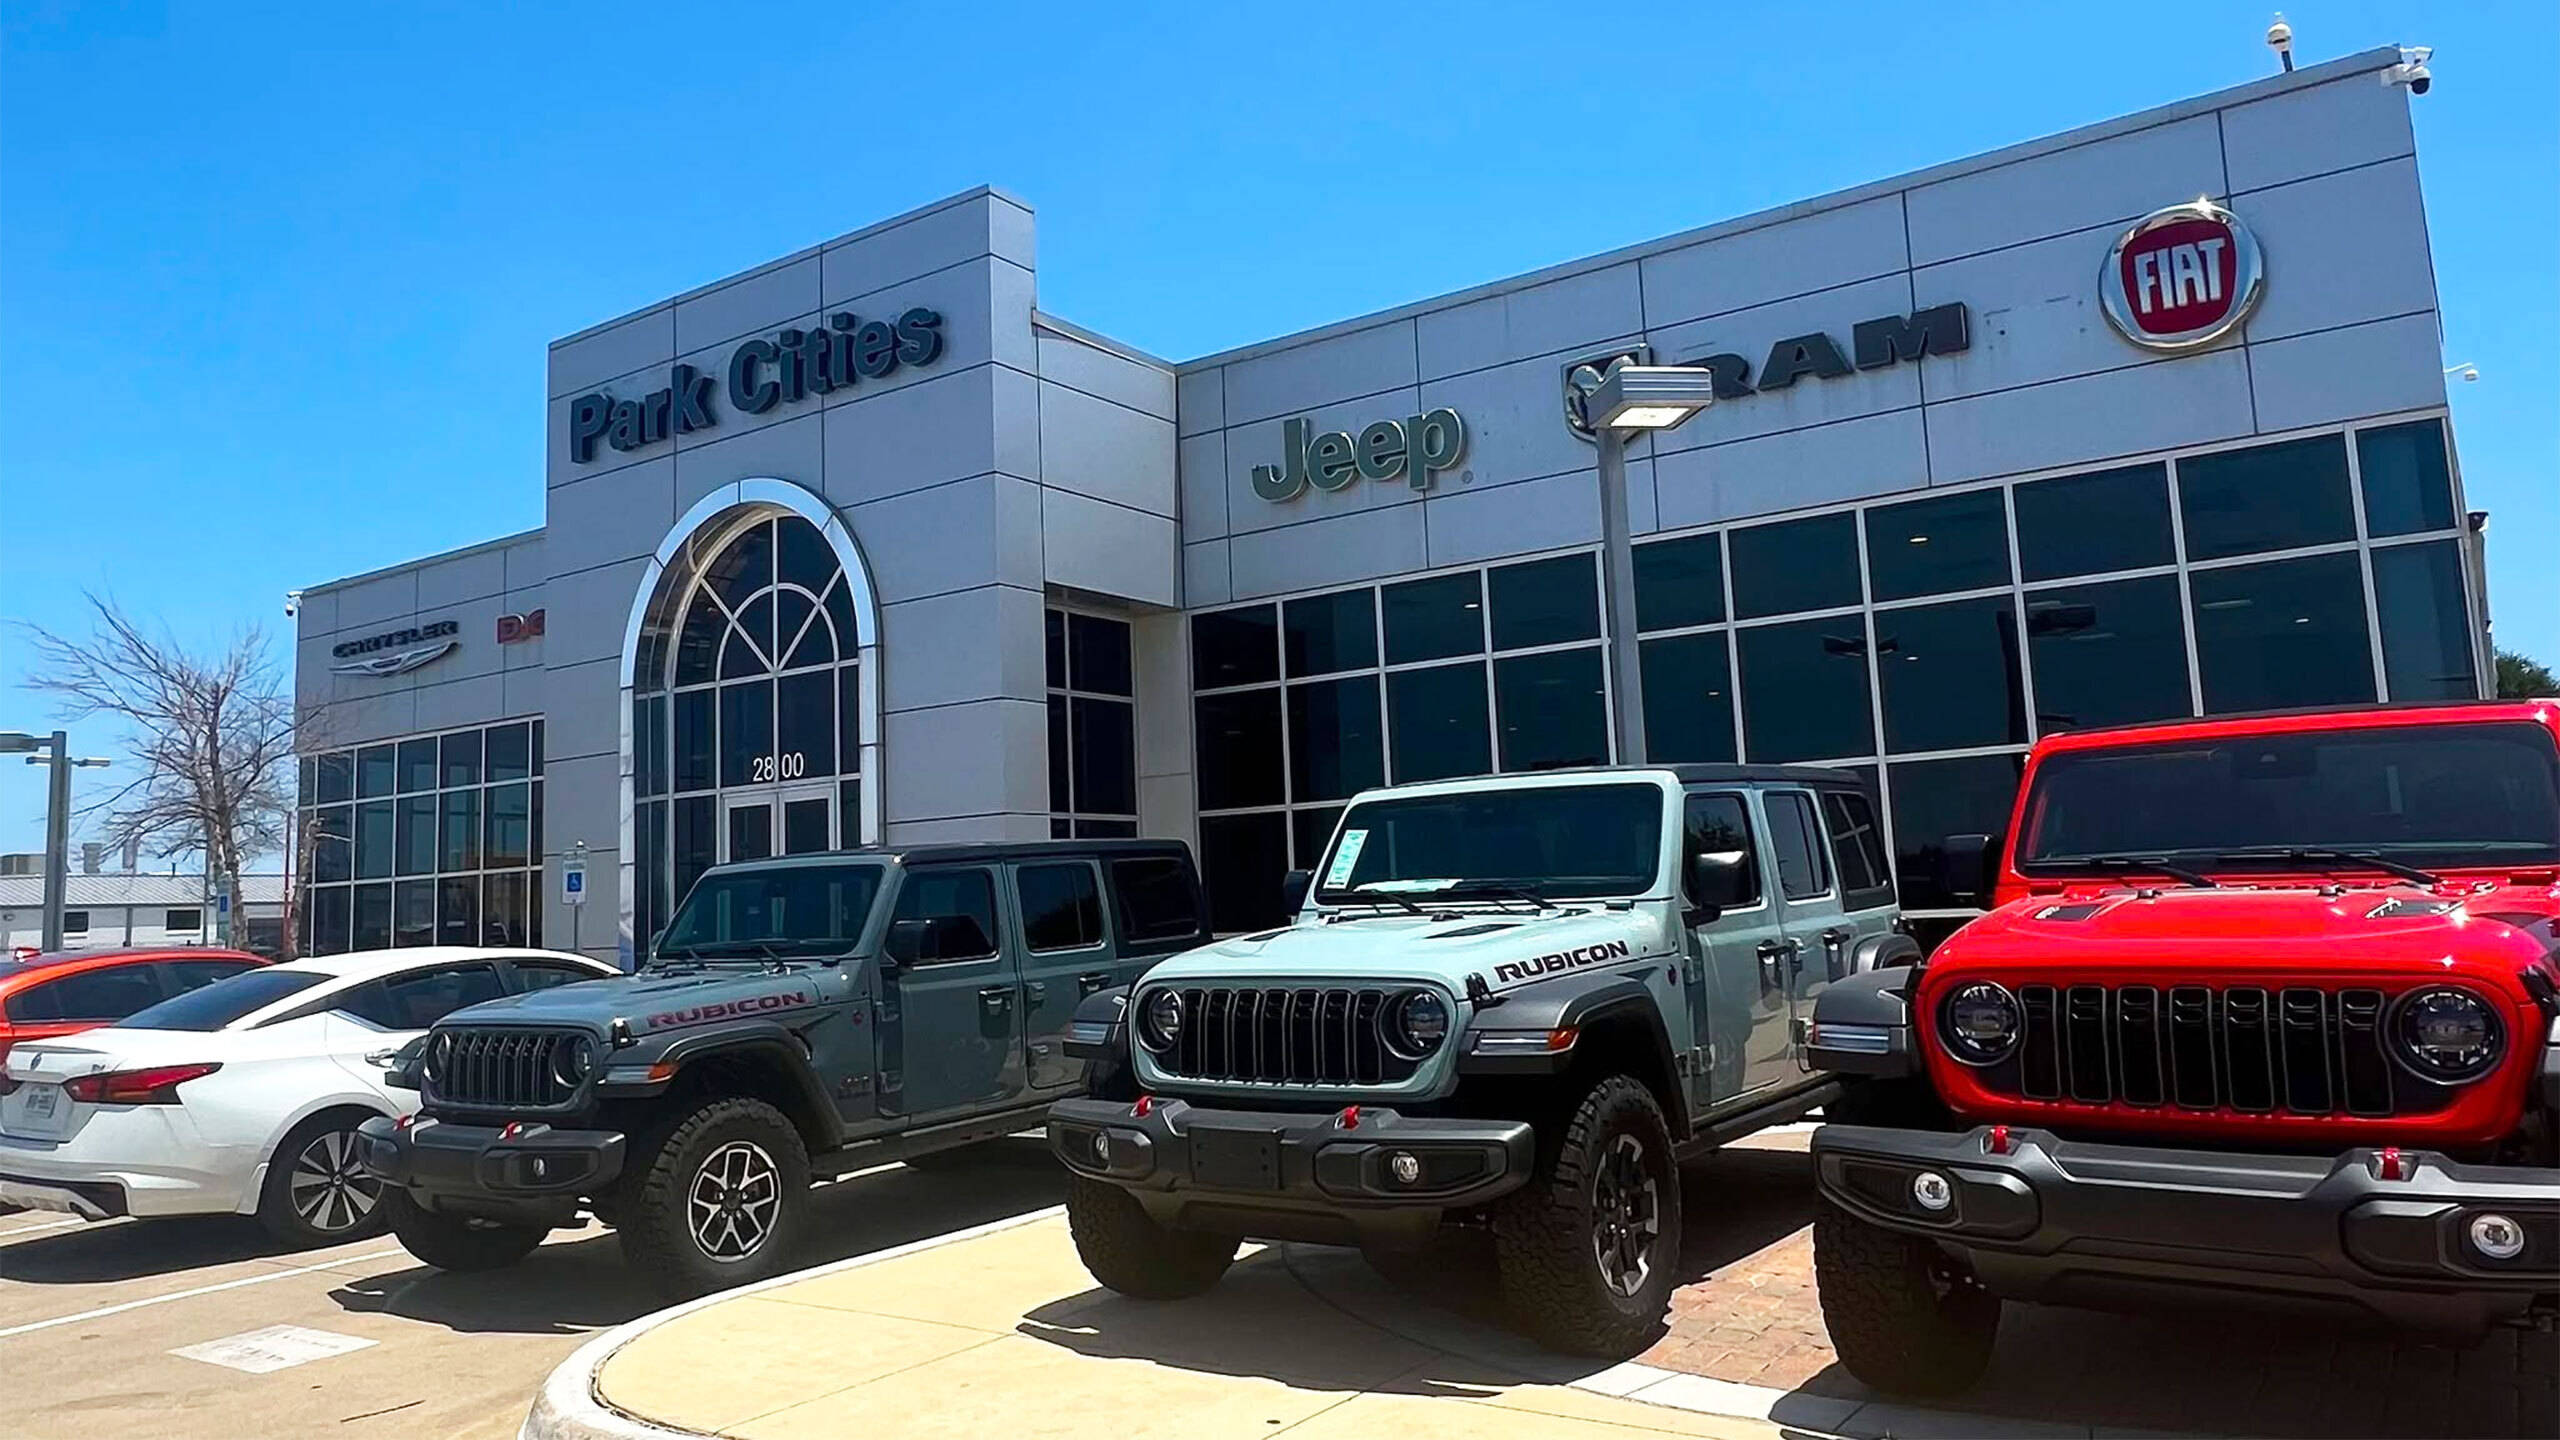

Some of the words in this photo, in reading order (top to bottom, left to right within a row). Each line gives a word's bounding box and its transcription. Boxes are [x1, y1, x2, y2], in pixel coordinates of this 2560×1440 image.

[2134, 238, 2226, 314] FIAT
[570, 363, 718, 464] Park
[728, 306, 944, 415] Cities
[1672, 301, 1970, 400] RAM
[1251, 407, 1468, 502] Jeep
[753, 752, 804, 782] 2800
[1493, 939, 1630, 983] RUBICON
[647, 991, 807, 1028] RUBICON
